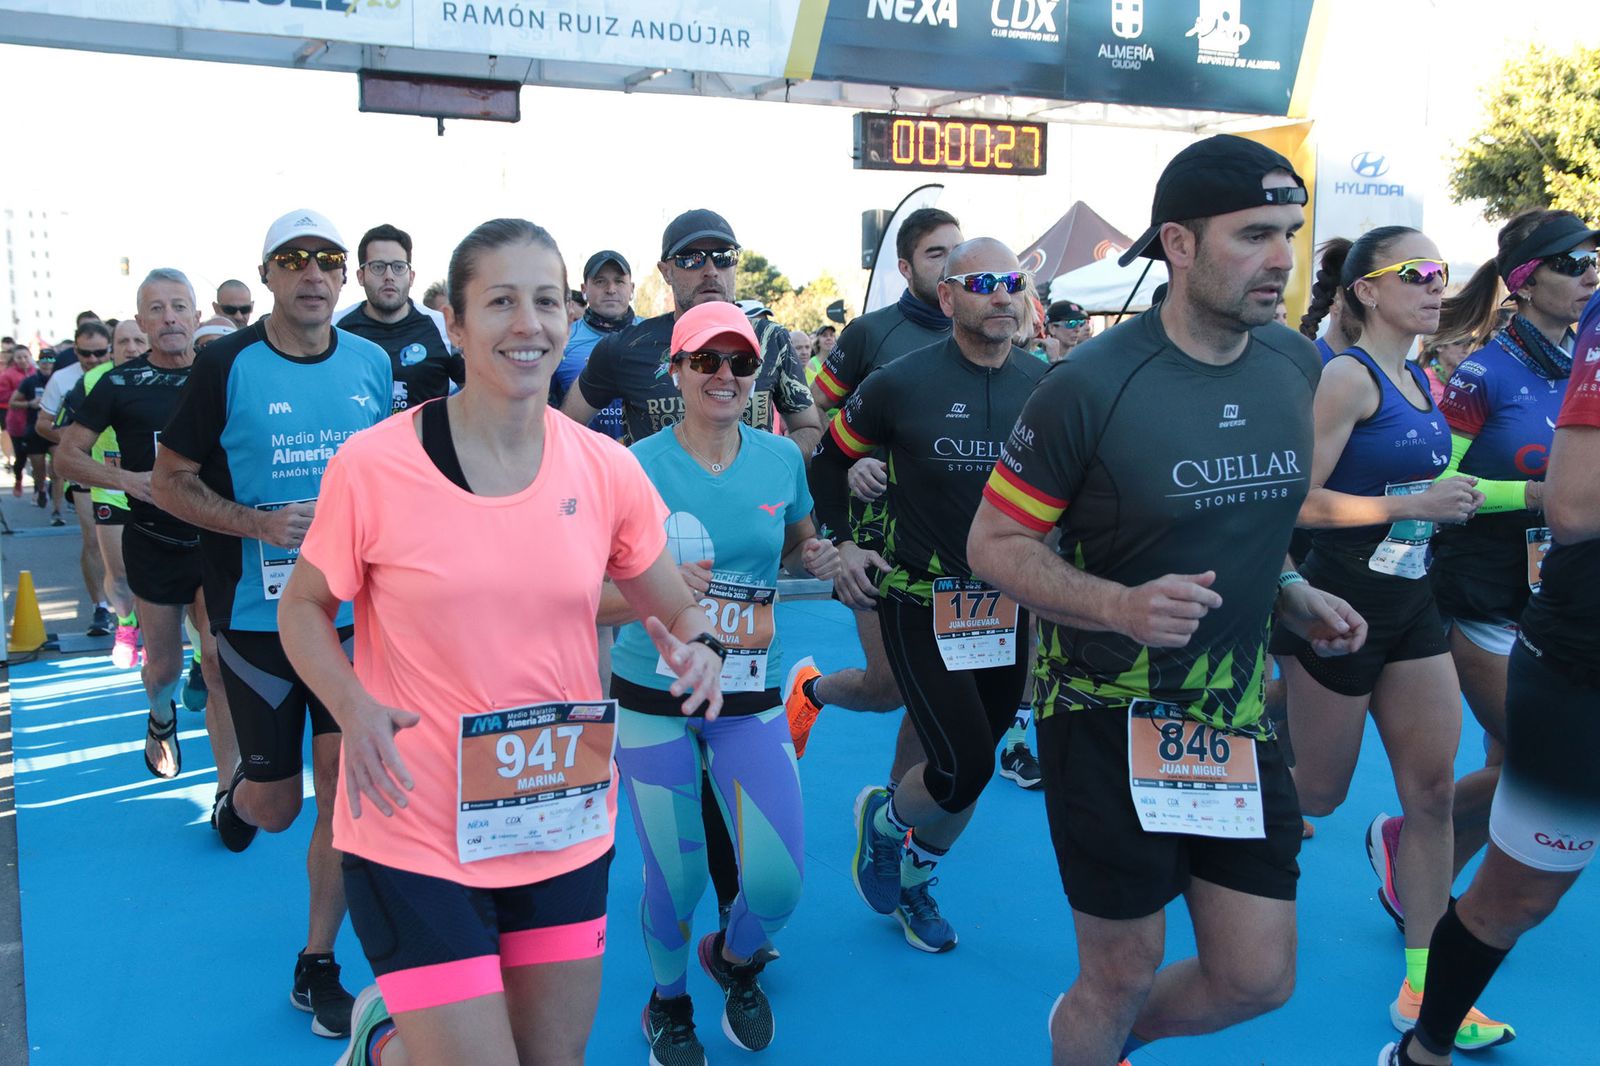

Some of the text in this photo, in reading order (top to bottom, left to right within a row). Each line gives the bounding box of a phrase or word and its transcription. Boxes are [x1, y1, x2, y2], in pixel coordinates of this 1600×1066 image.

[866, 0, 958, 28] NEXA
[990, 0, 1057, 33] CDX
[442, 2, 751, 48] RAMÓN RUIZ ANDÚJAR
[991, 28, 1008, 38] CLUB
[1008, 29, 1042, 41] DEPORTIVO
[1097, 43, 1155, 62] ALMERÍA
[1112, 59, 1142, 70] CIUDAD
[892, 119, 1041, 169] 00:00:27
[1335, 182, 1404, 197] HYUNDAI
[598, 406, 623, 416] asa
[757, 394, 768, 423] TEAM
[272, 432, 315, 447] Medio
[1395, 437, 1427, 448] SPIRAL
[272, 444, 335, 465] Almería
[272, 466, 309, 479] RAMÓN
[949, 464, 994, 472] STONE
[1172, 450, 1301, 487] CUELLAR
[1195, 488, 1289, 510] STONE 1958
[709, 589, 748, 600] Almería 2022
[710, 583, 728, 591] Medio
[950, 592, 1001, 619] 177
[949, 620, 966, 629] JUAN
[966, 618, 1000, 626] GUEVARA
[507, 706, 557, 720] Medio Maratón
[507, 713, 556, 728] Almería 2022
[1158, 721, 1232, 765] 846
[496, 724, 584, 778] 947
[1158, 763, 1190, 775] JUAN
[1192, 765, 1228, 777] MIGUEL
[517, 771, 566, 790] MARINA
[467, 815, 523, 829] NEXA CDX
[1534, 832, 1594, 851] GALO
